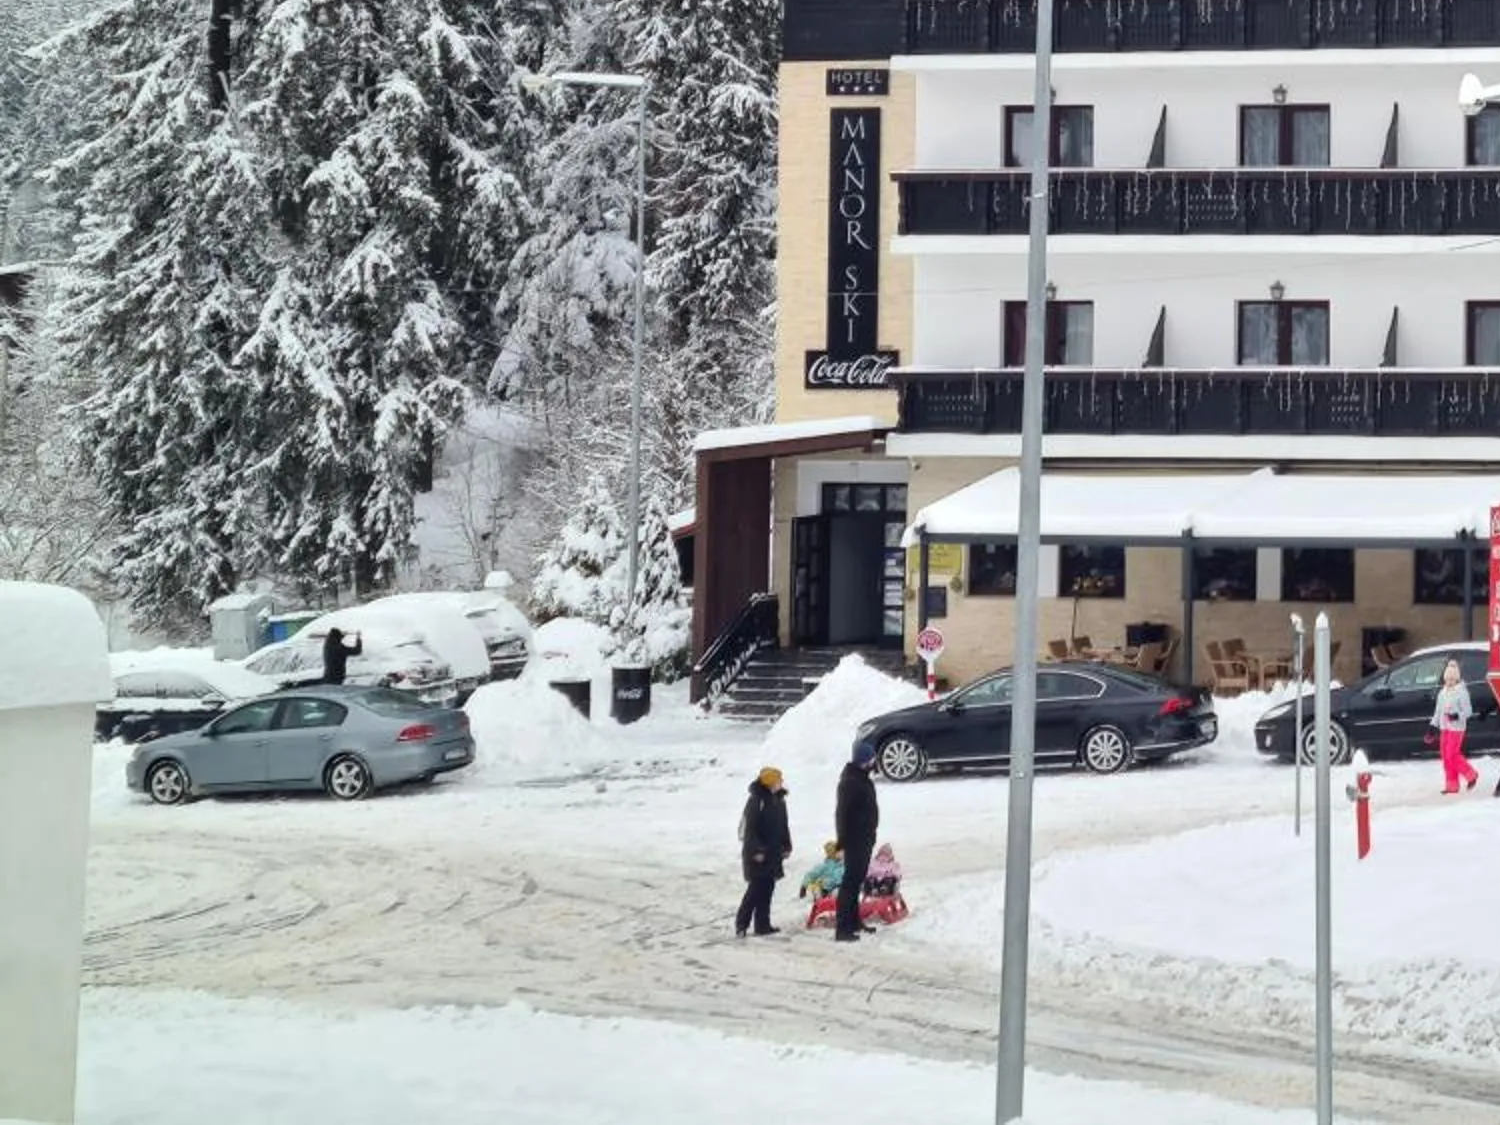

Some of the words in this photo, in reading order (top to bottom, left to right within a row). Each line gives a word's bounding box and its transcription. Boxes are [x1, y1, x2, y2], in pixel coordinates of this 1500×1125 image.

[831, 72, 883, 84] HOTEL
[839, 115, 872, 250] MANOR
[843, 266, 860, 343] SKI
[808, 355, 894, 384] Coca-Cola
